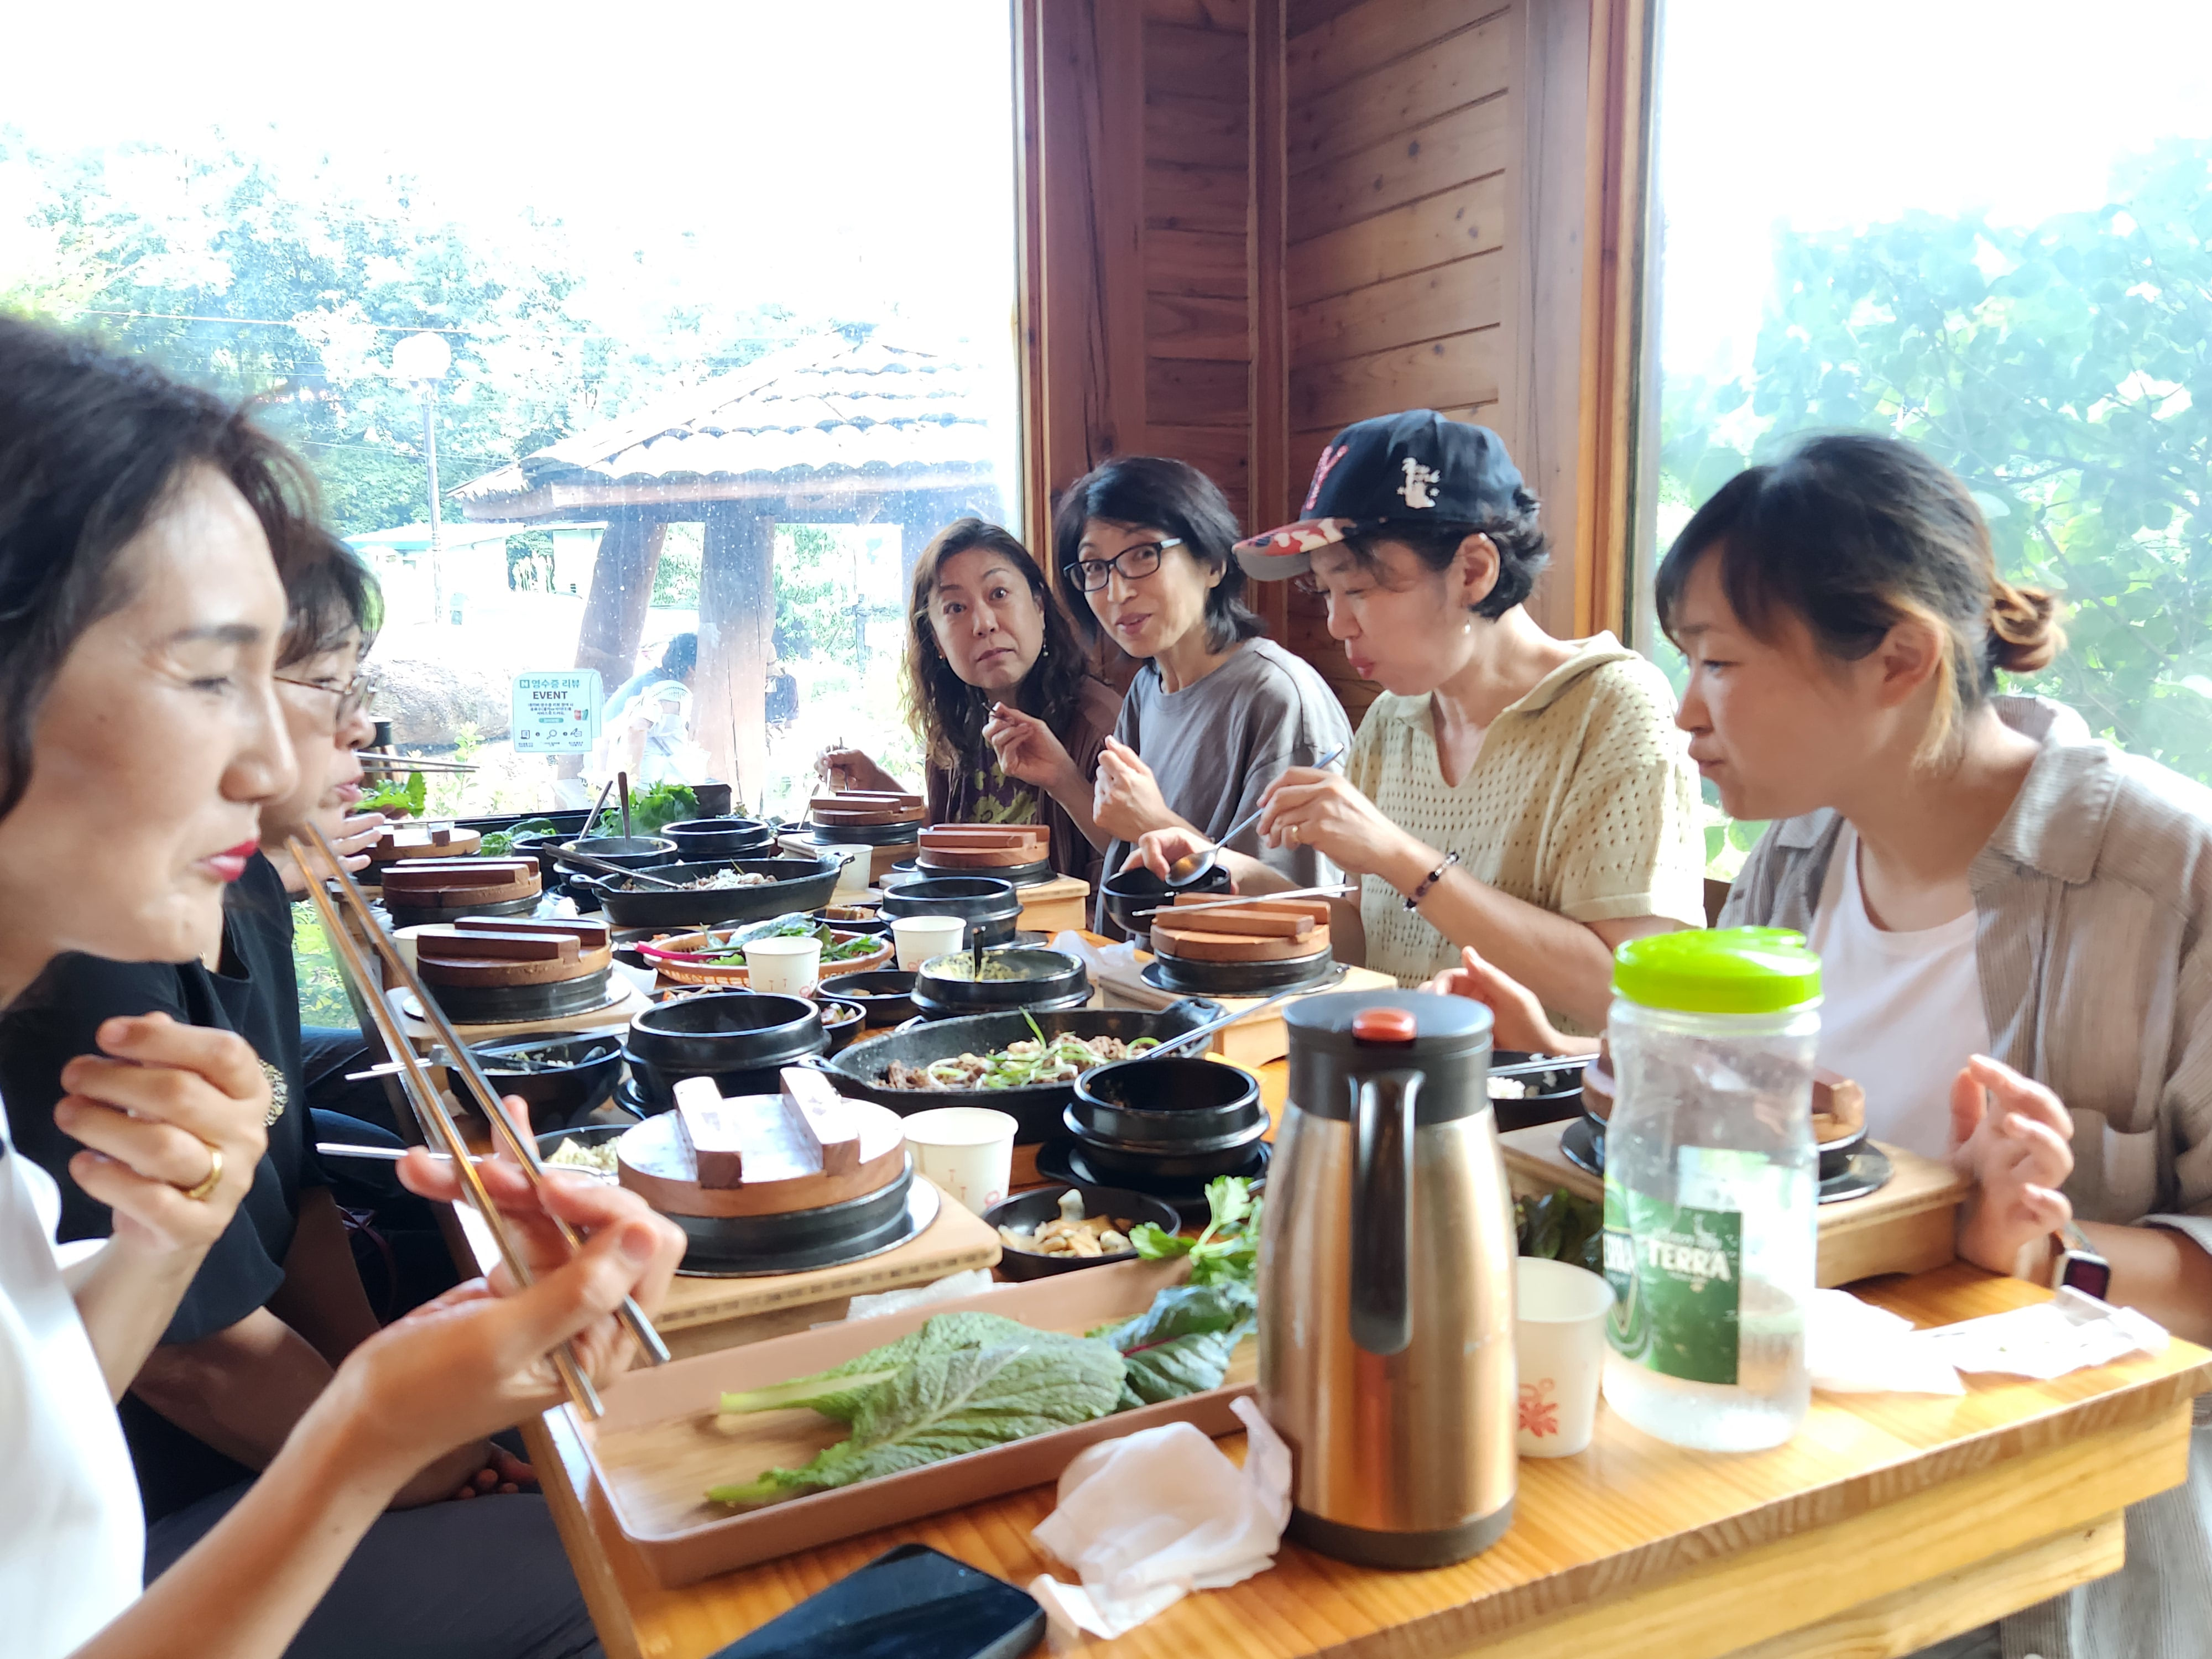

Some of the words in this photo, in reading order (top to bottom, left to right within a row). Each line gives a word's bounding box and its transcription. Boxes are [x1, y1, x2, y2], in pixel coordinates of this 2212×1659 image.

[531, 679, 559, 688] 영수증
[562, 679, 580, 688] 리뷰
[533, 691, 568, 700] EVENT
[1645, 1239, 1731, 1282] TERRA
